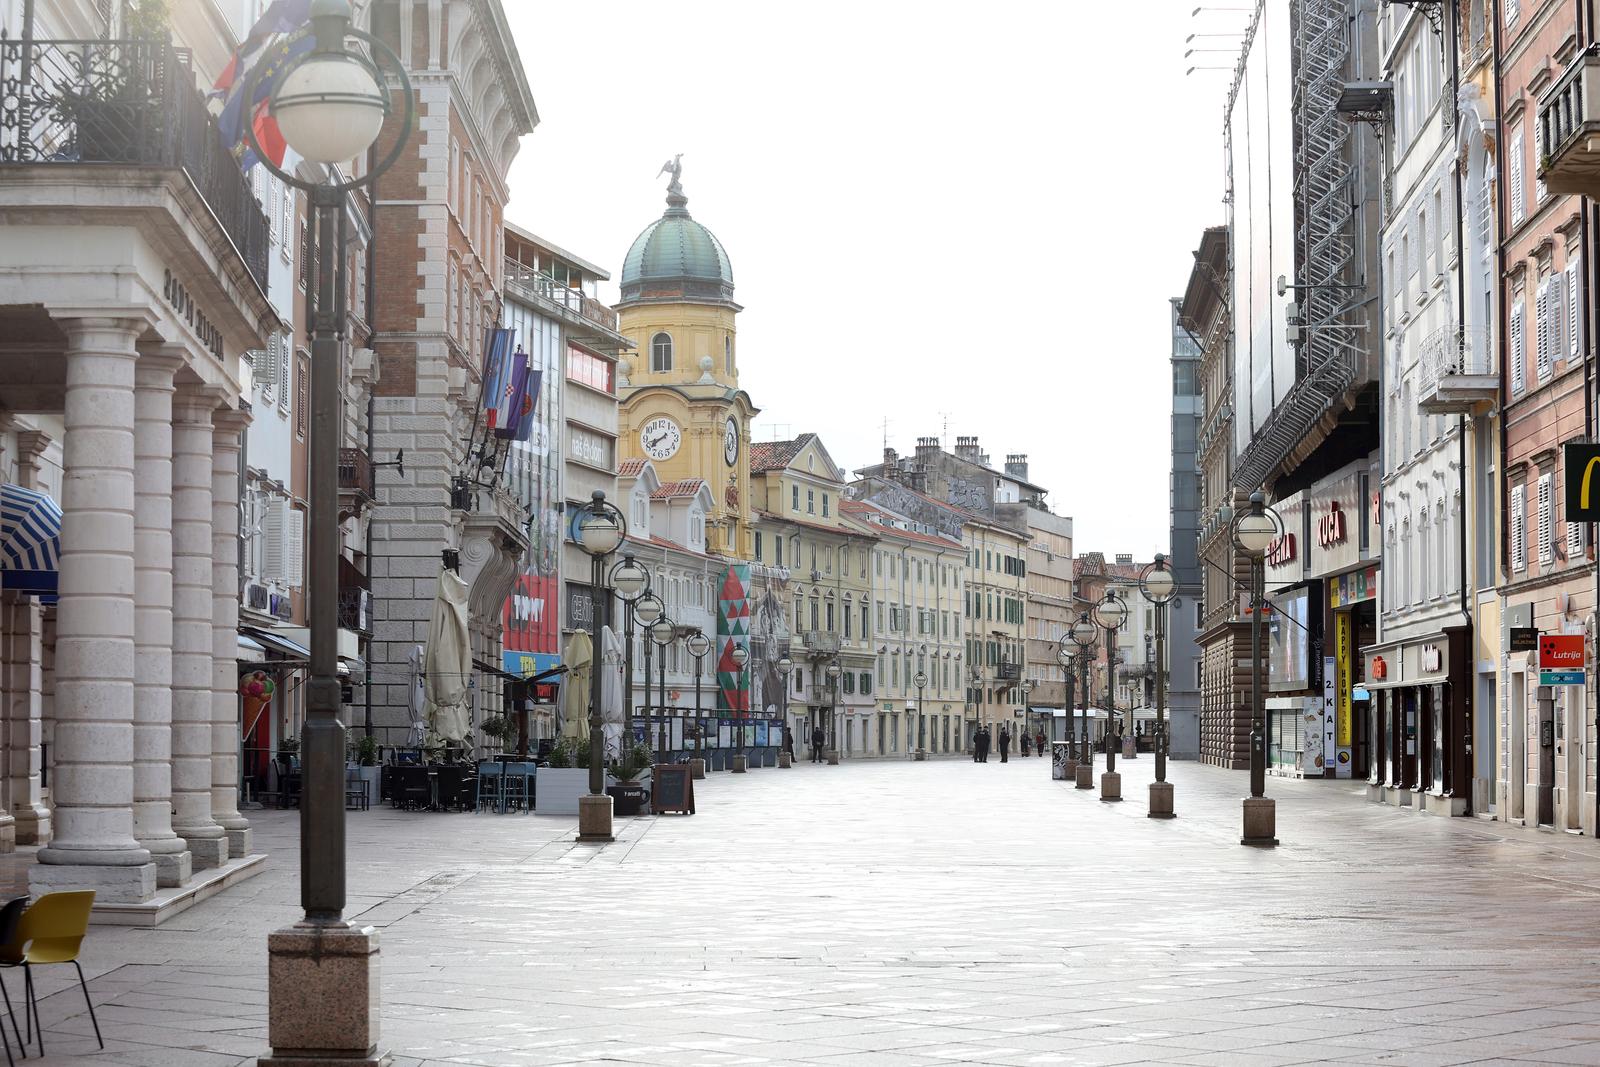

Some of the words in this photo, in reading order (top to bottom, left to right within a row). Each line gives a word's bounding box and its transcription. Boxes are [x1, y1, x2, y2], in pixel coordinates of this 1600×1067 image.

[658, 420, 666, 429] 12
[643, 434, 649, 443] 9
[674, 433, 679, 443] 3
[657, 450, 664, 458] 6
[1317, 501, 1345, 546] KUĆA
[1553, 651, 1581, 660] Lutrija
[1325, 680, 1334, 689] 2.
